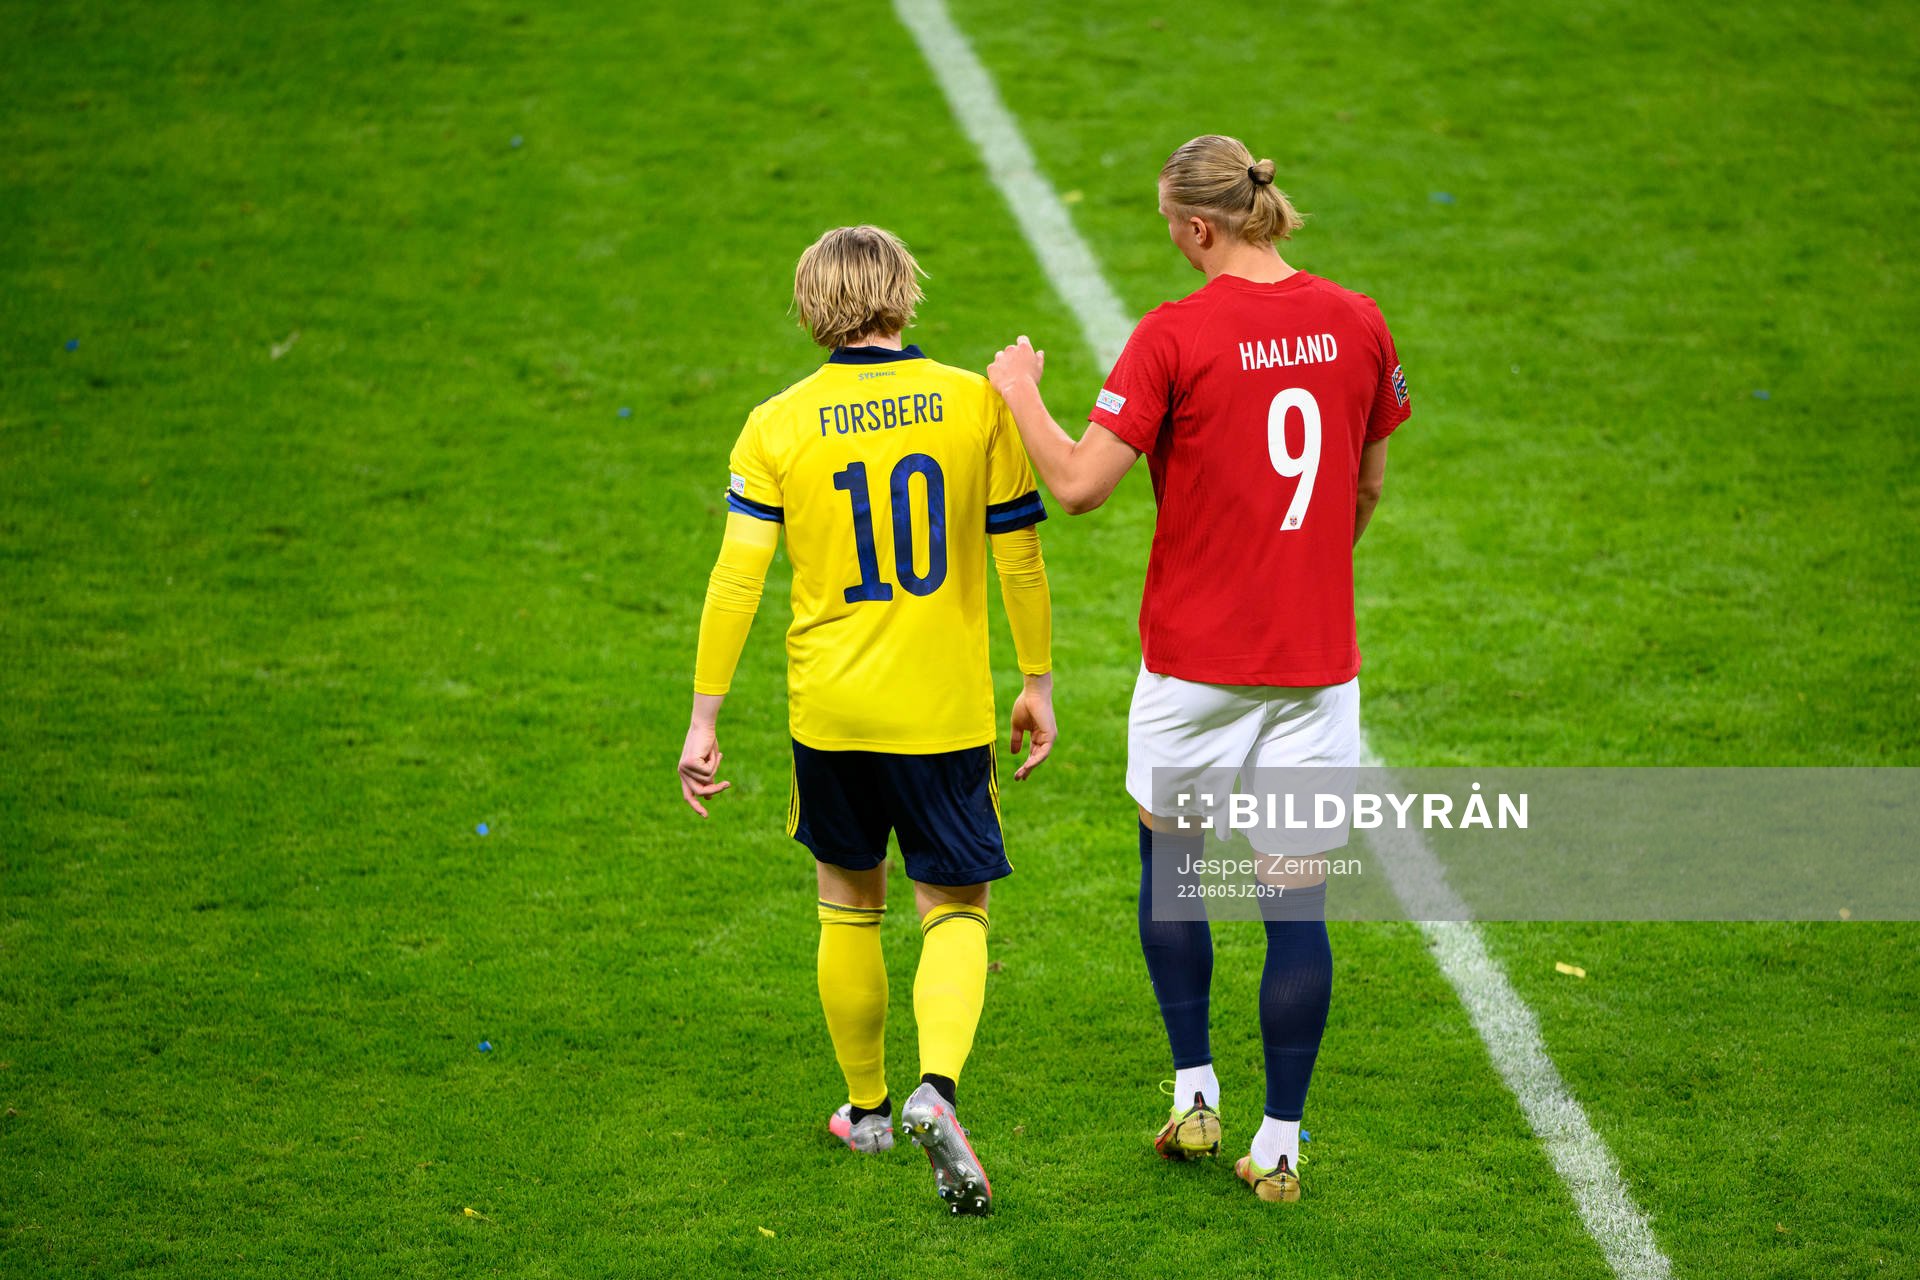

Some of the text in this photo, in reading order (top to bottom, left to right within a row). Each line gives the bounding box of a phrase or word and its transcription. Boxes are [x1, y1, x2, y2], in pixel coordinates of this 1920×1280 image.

[1238, 333, 1338, 371] HAALAND
[819, 392, 943, 437] FORSBERG
[1267, 387, 1322, 531] 9
[833, 453, 947, 604] 10
